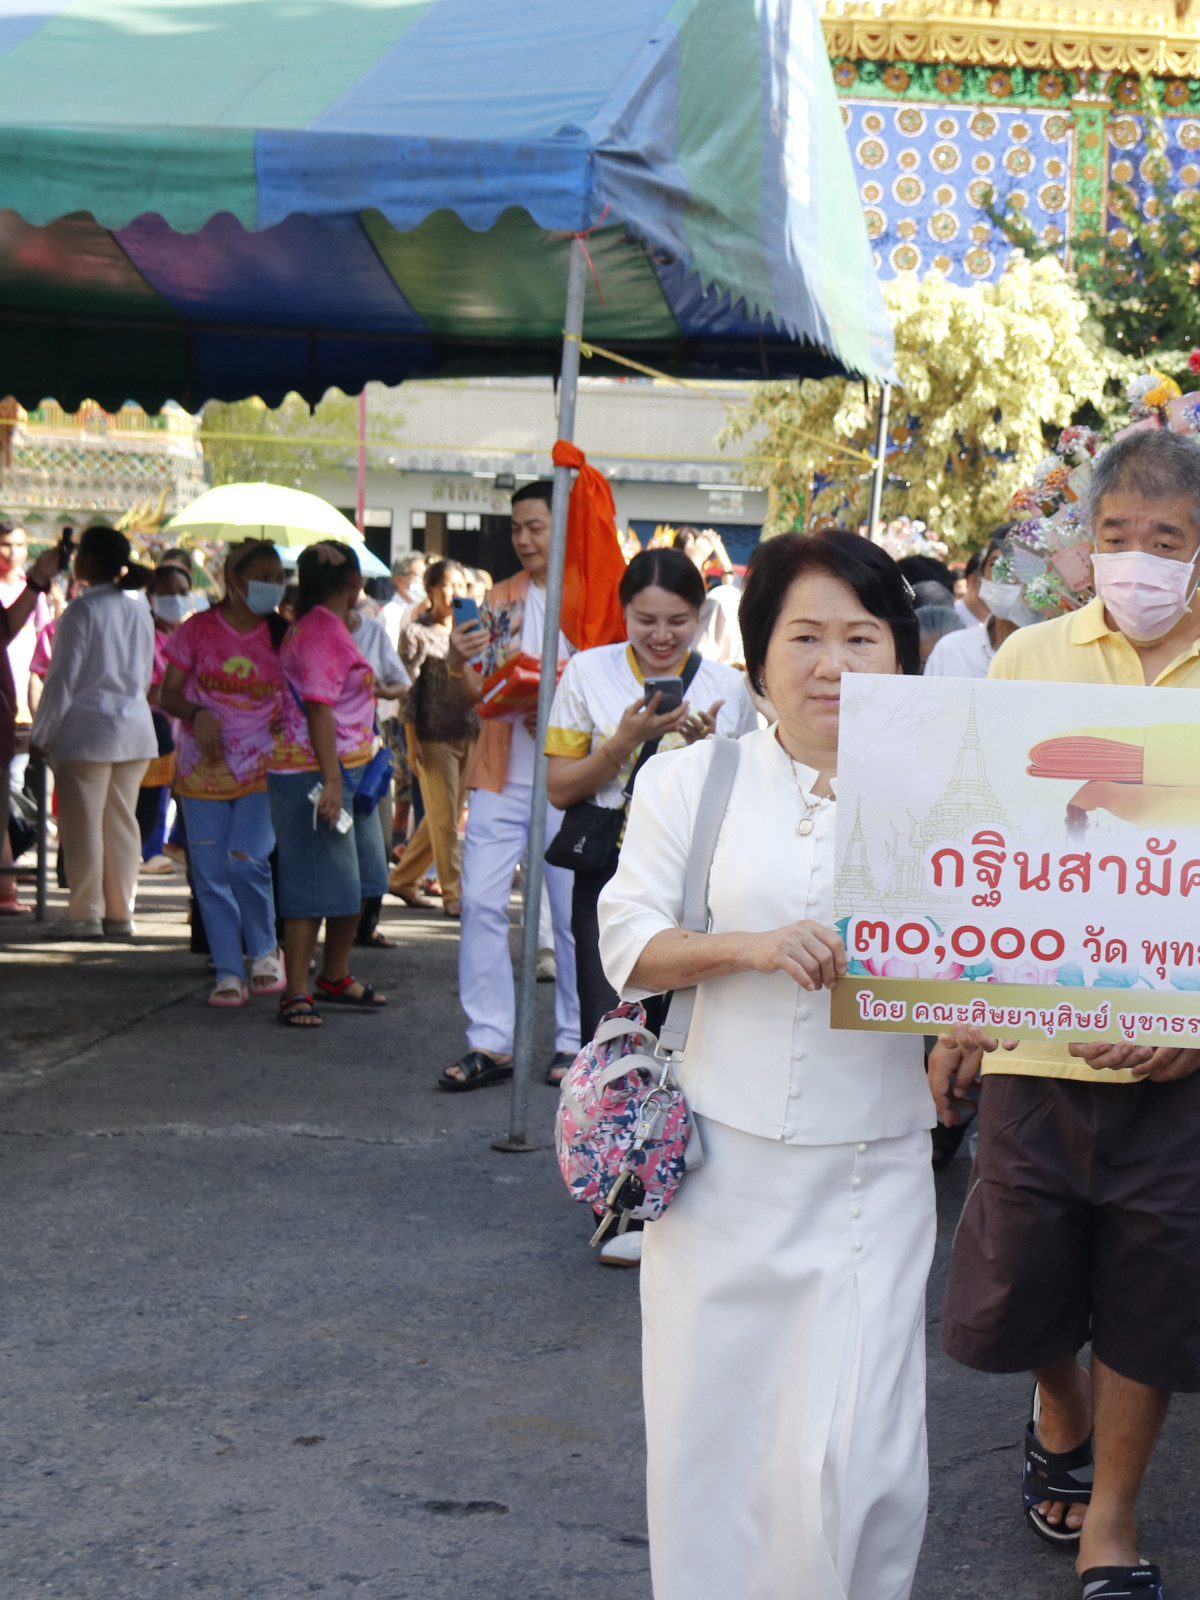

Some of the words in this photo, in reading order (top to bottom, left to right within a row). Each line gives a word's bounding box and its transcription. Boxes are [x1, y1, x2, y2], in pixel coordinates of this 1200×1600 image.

[854, 919, 1065, 966] ๓๐,๐๐๐
[1082, 924, 1128, 965] วัด
[859, 994, 904, 1020] โดย
[914, 1000, 1109, 1038] คณะศิษยานุศิษย์
[1029, 1450, 1048, 1465] ADDA
